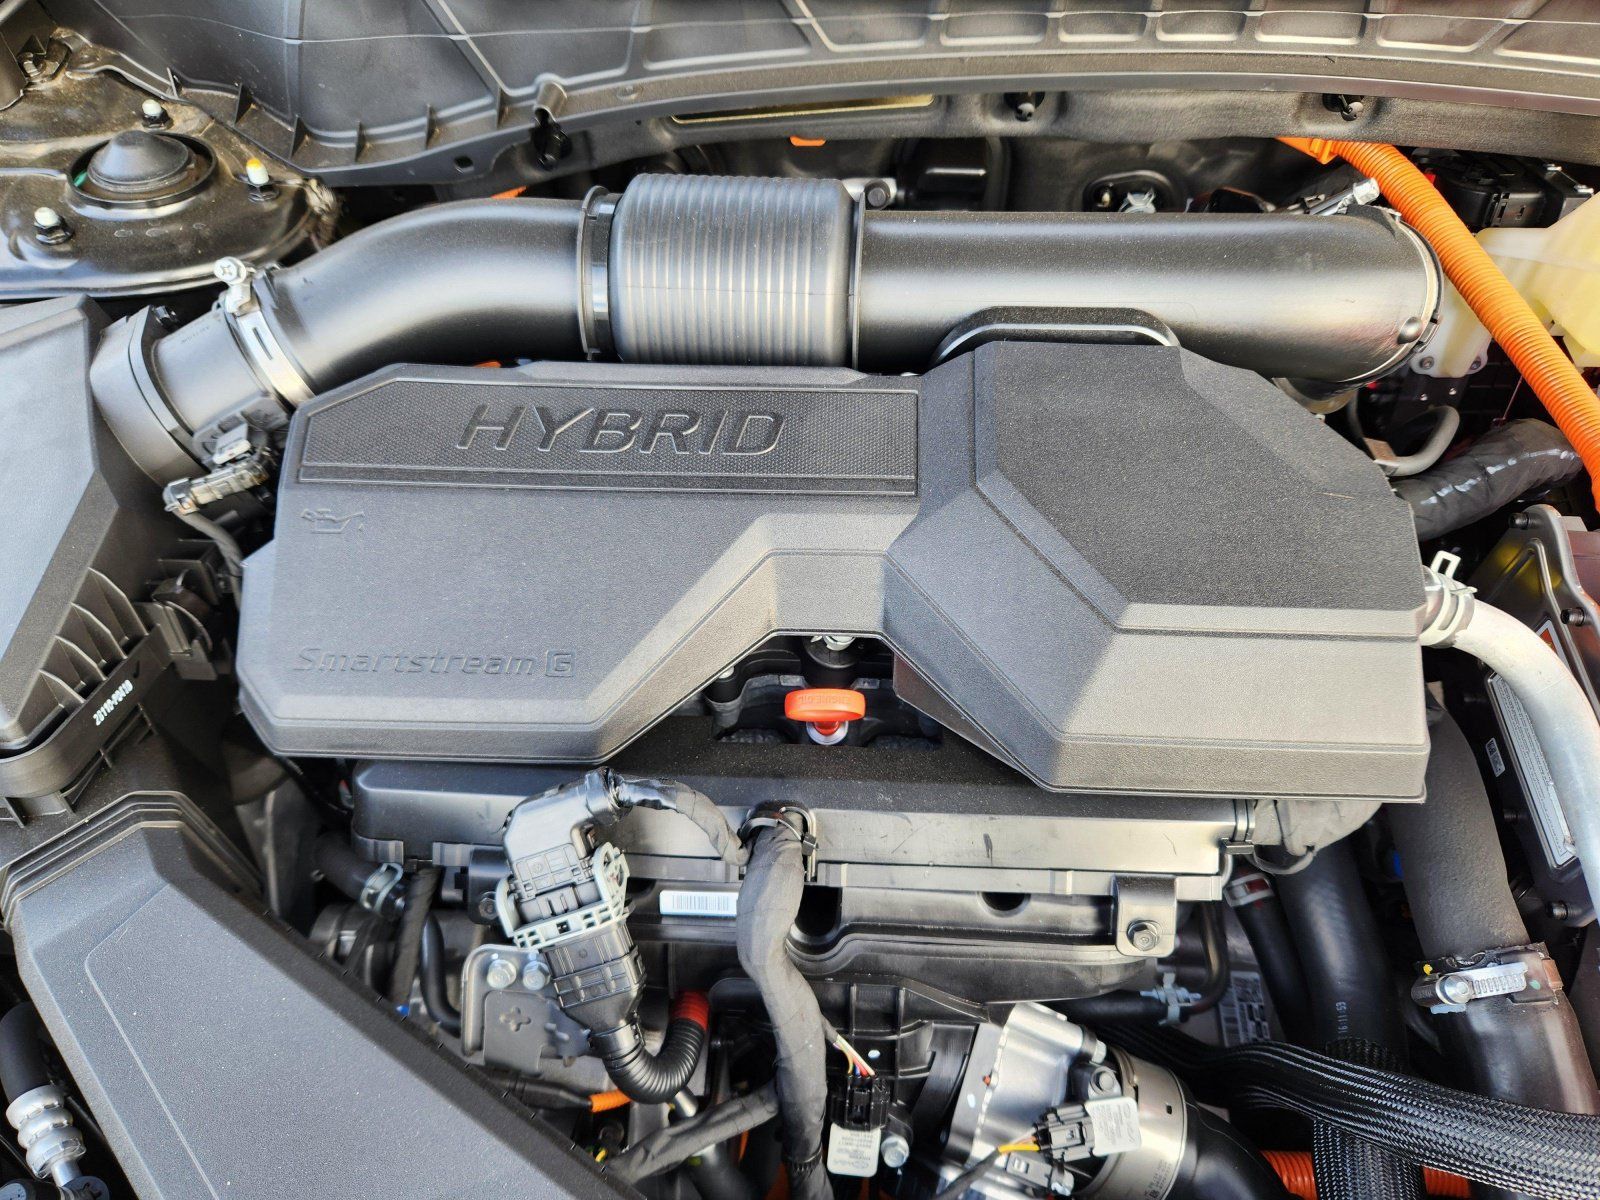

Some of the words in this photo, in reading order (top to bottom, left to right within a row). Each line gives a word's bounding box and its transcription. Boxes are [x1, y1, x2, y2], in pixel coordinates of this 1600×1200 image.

[456, 404, 787, 456] HYBRID
[293, 647, 537, 676] Smartstream
[548, 650, 575, 677] G
